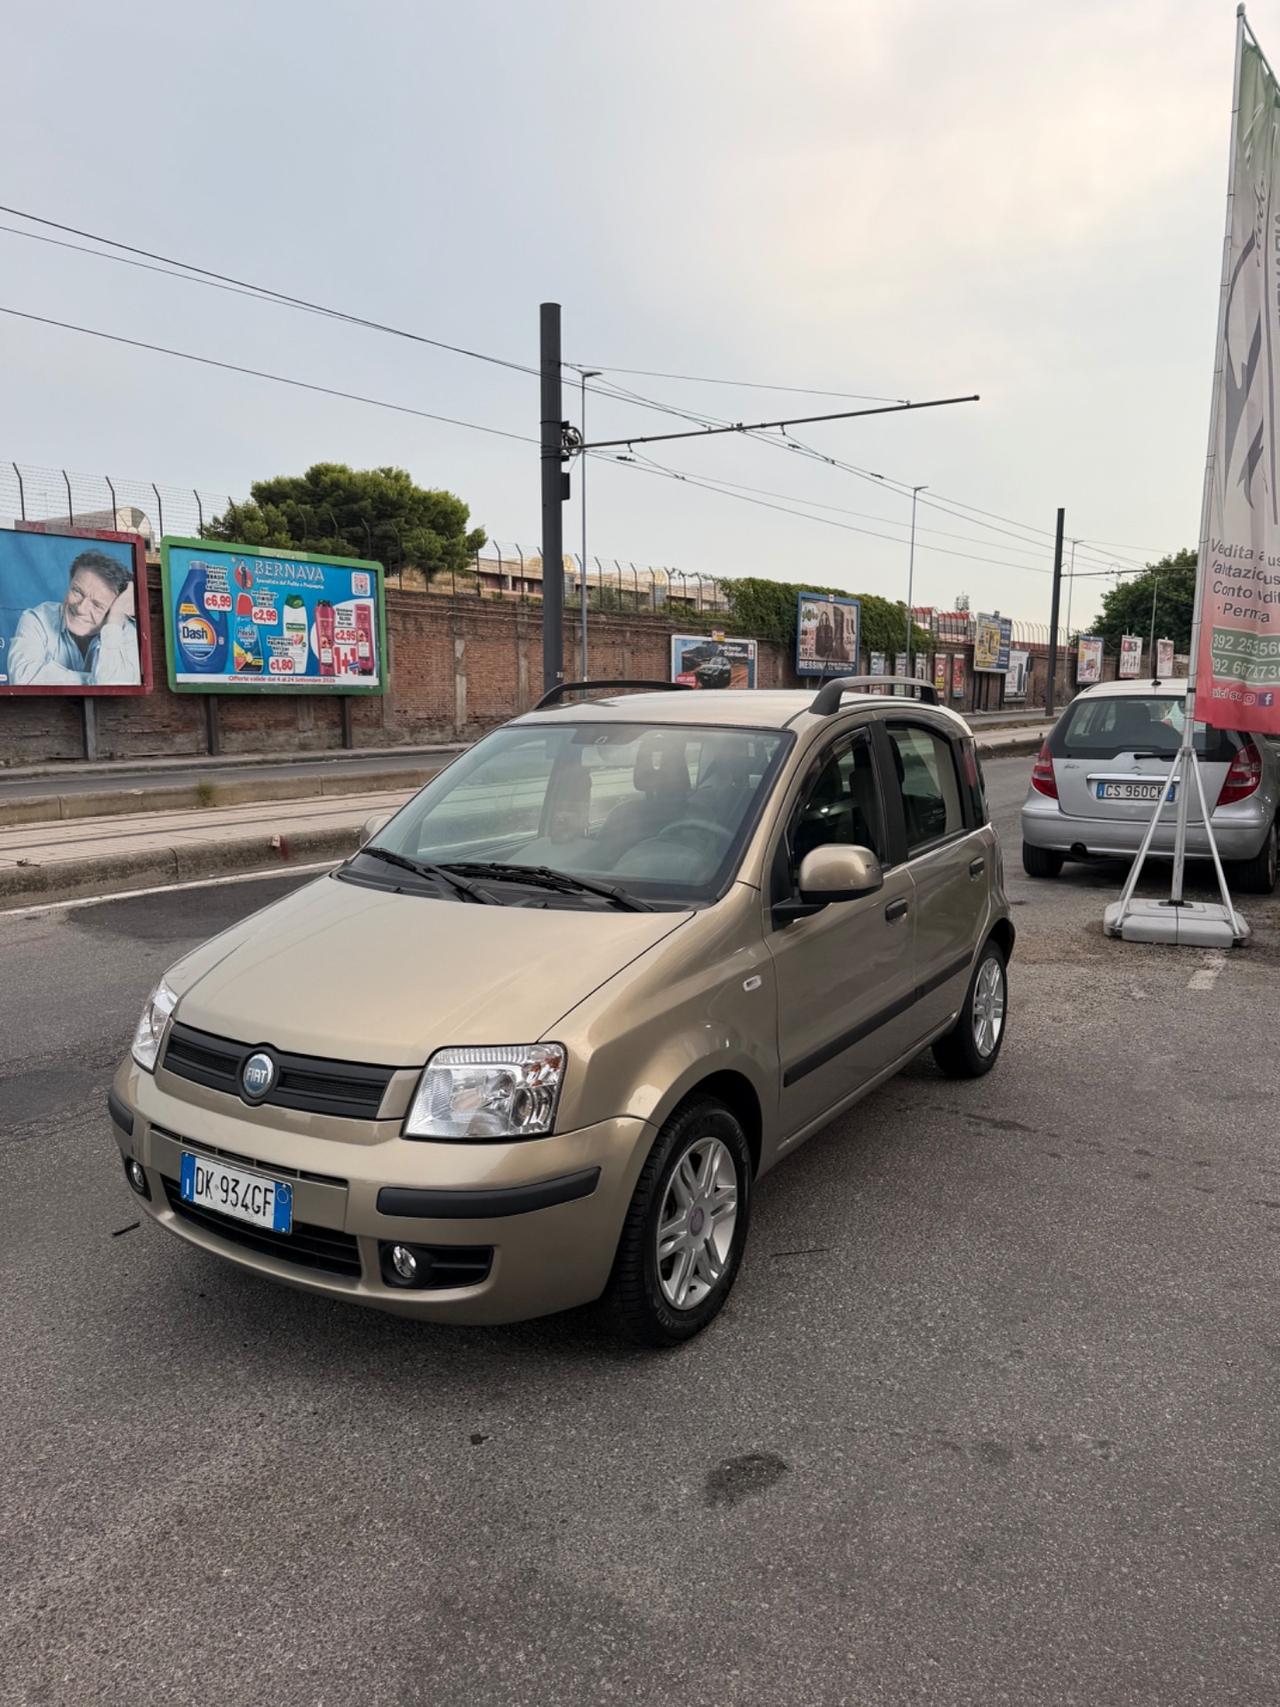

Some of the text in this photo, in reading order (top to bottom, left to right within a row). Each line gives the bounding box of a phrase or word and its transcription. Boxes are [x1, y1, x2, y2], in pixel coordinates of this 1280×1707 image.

[255, 561, 324, 582] BERNAVA
[1213, 580, 1253, 599] Conto
[182, 626, 208, 640] Dash
[1105, 785, 1120, 797] CS
[246, 1067, 268, 1084] FIAT
[195, 1166, 214, 1201] DK
[220, 1175, 274, 1217] 934GF
